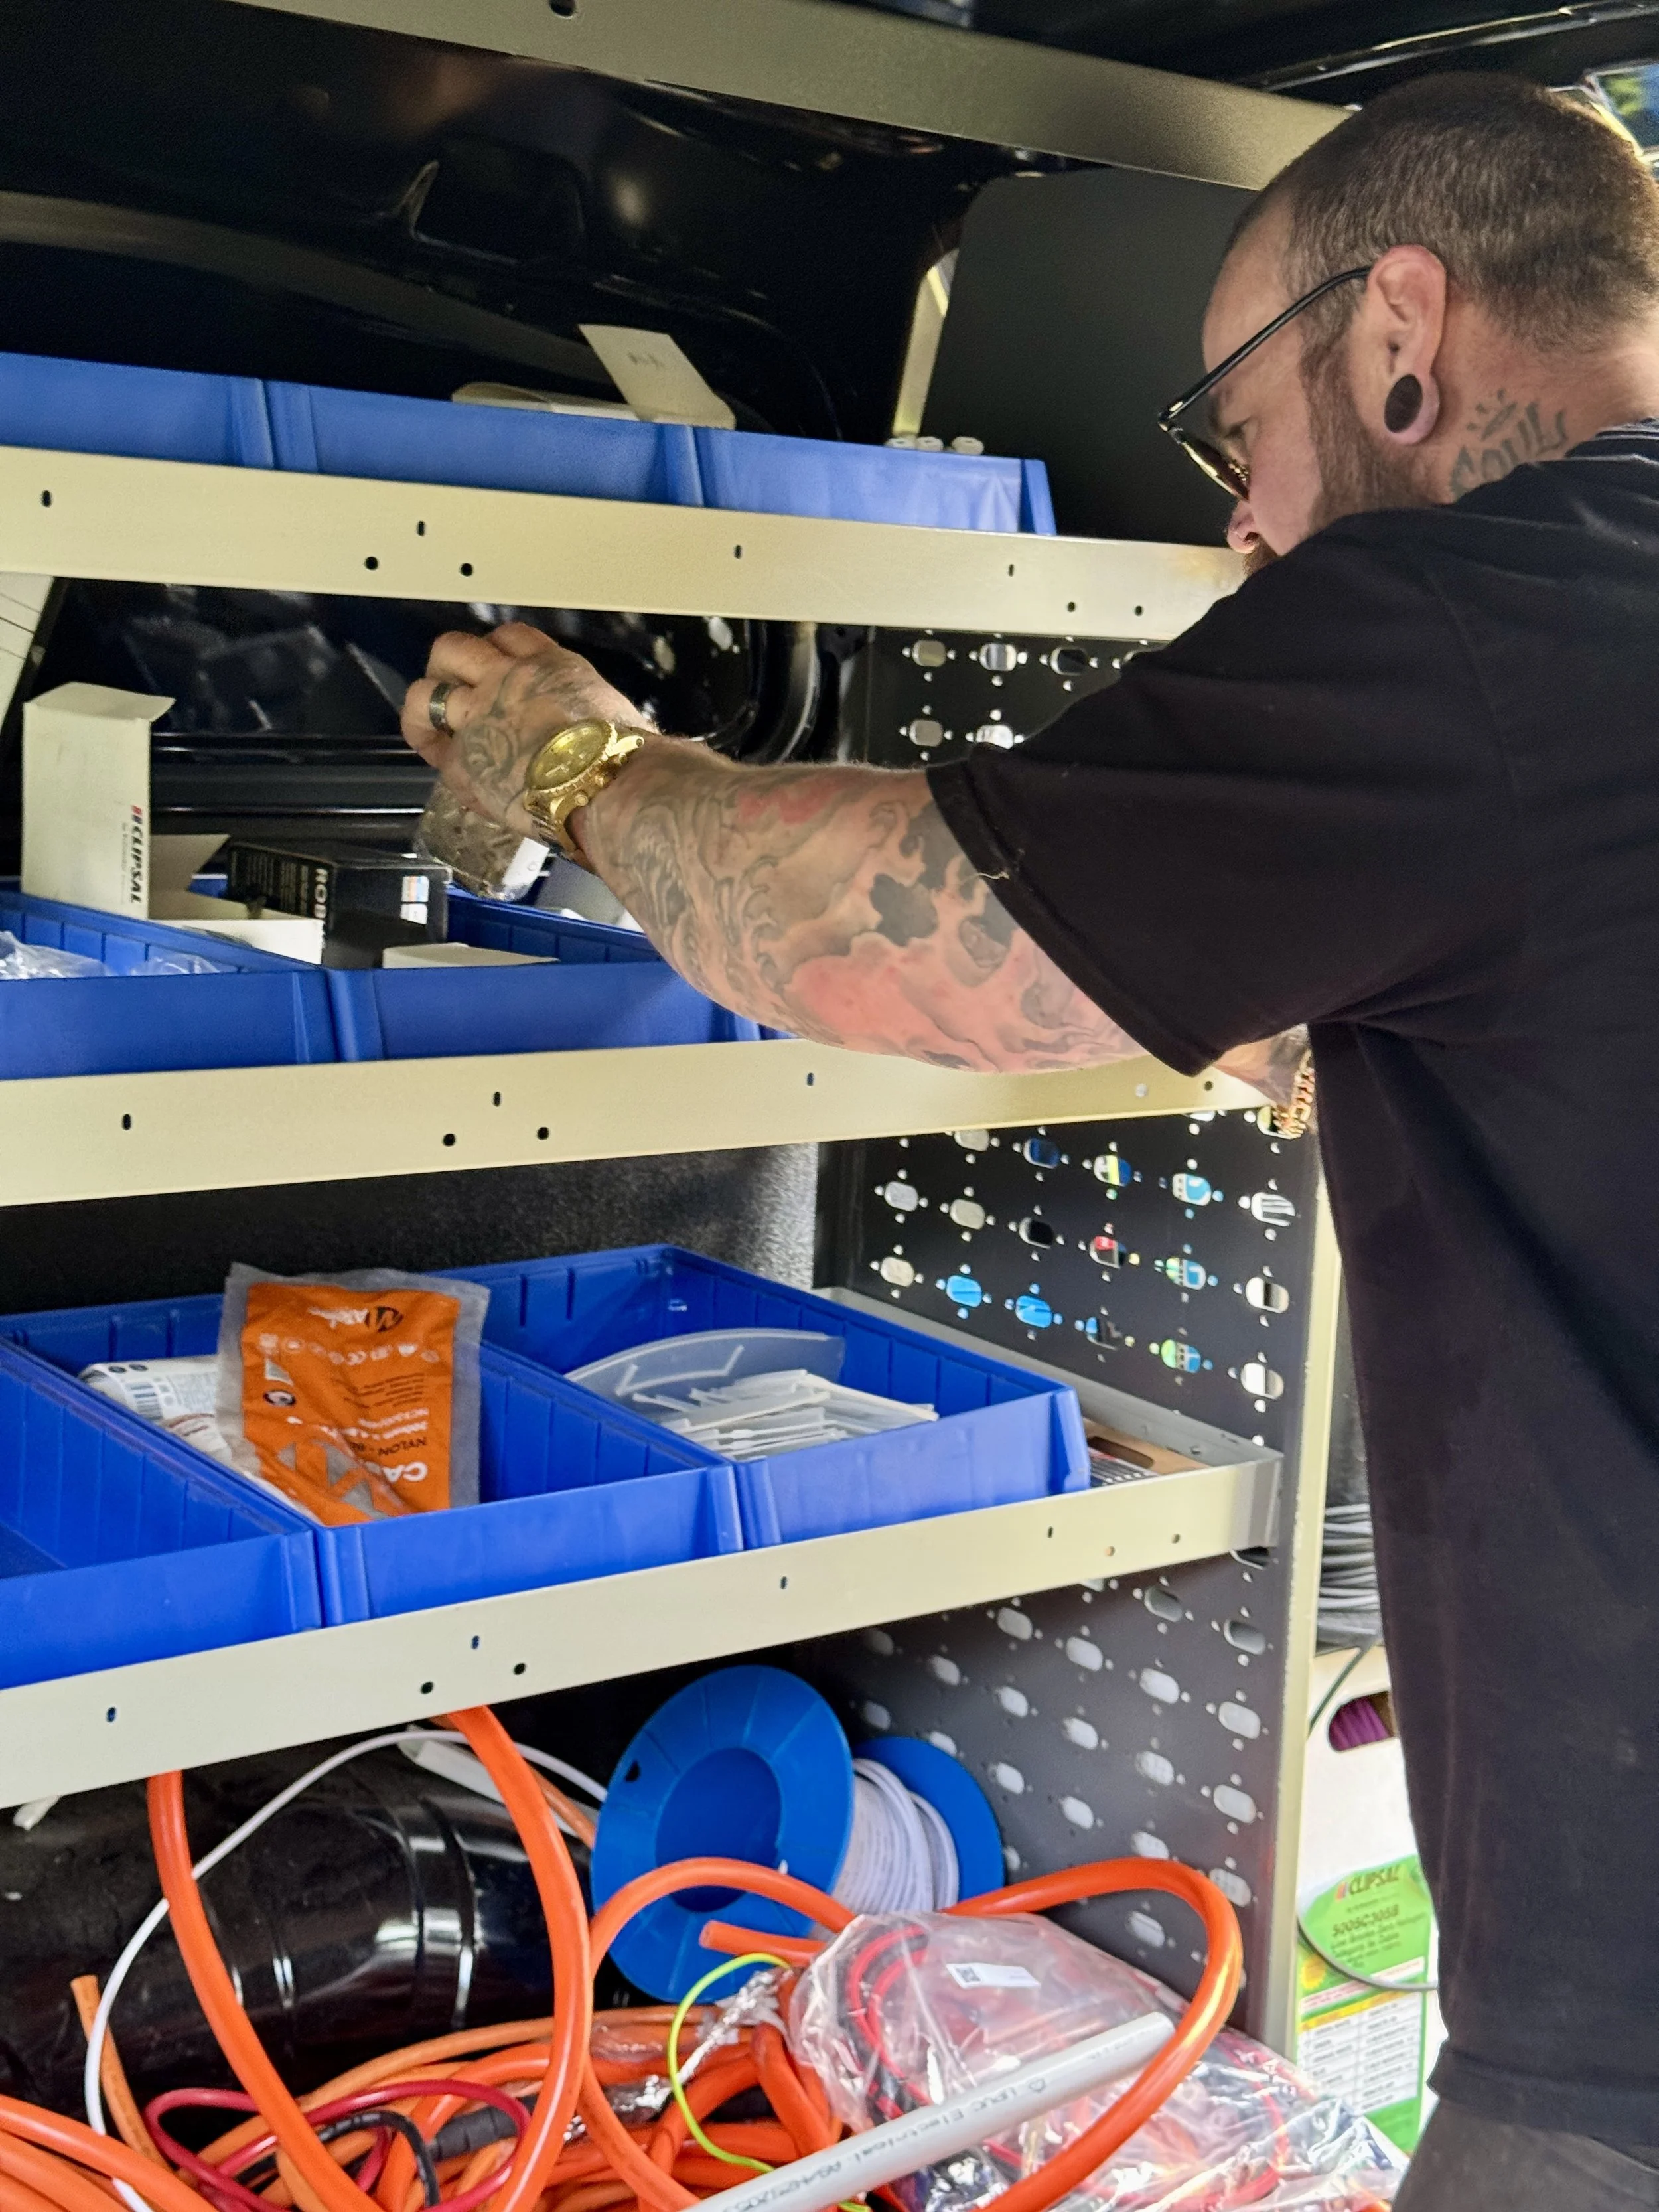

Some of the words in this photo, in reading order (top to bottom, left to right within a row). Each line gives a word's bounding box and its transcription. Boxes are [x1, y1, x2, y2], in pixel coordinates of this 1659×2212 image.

[130, 825, 143, 904] CLIPSAL
[380, 1461, 429, 1483] CA
[1348, 1864, 1401, 1895] CLIPSAL
